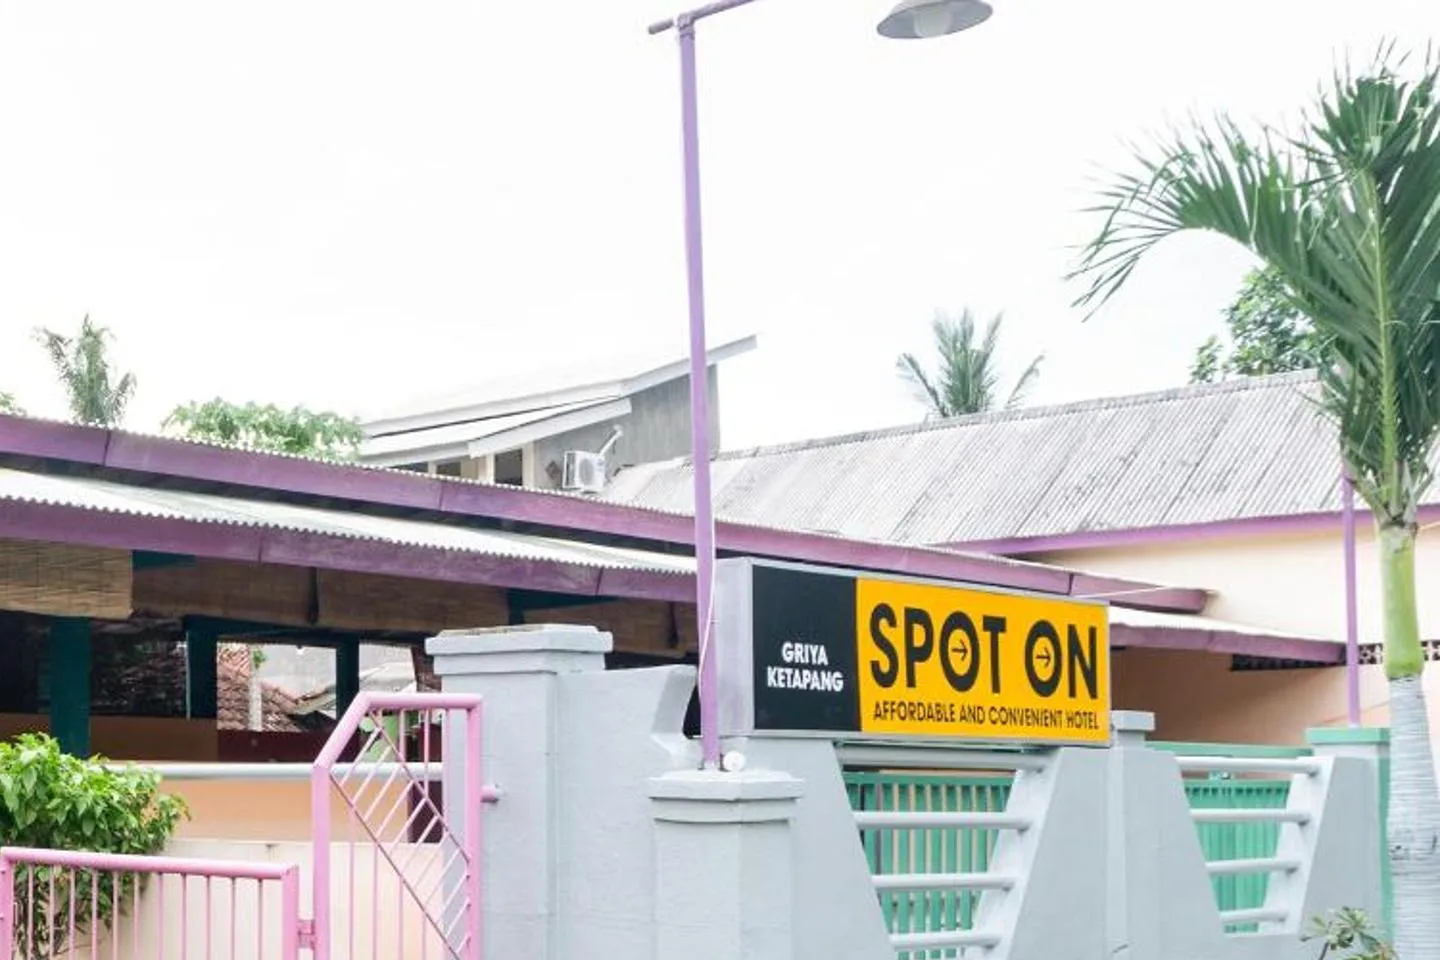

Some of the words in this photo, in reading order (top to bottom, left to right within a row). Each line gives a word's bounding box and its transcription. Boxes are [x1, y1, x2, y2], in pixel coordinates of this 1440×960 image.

[782, 642, 828, 666] GRIYA
[869, 602, 1007, 694] SPOT
[1024, 619, 1099, 700] ON
[767, 666, 844, 692] KETAPANG
[873, 700, 956, 723] AFFORDABLE
[959, 704, 986, 724] AND
[989, 706, 1063, 728] CONVENIENT
[1066, 710, 1100, 730] HOTEL
